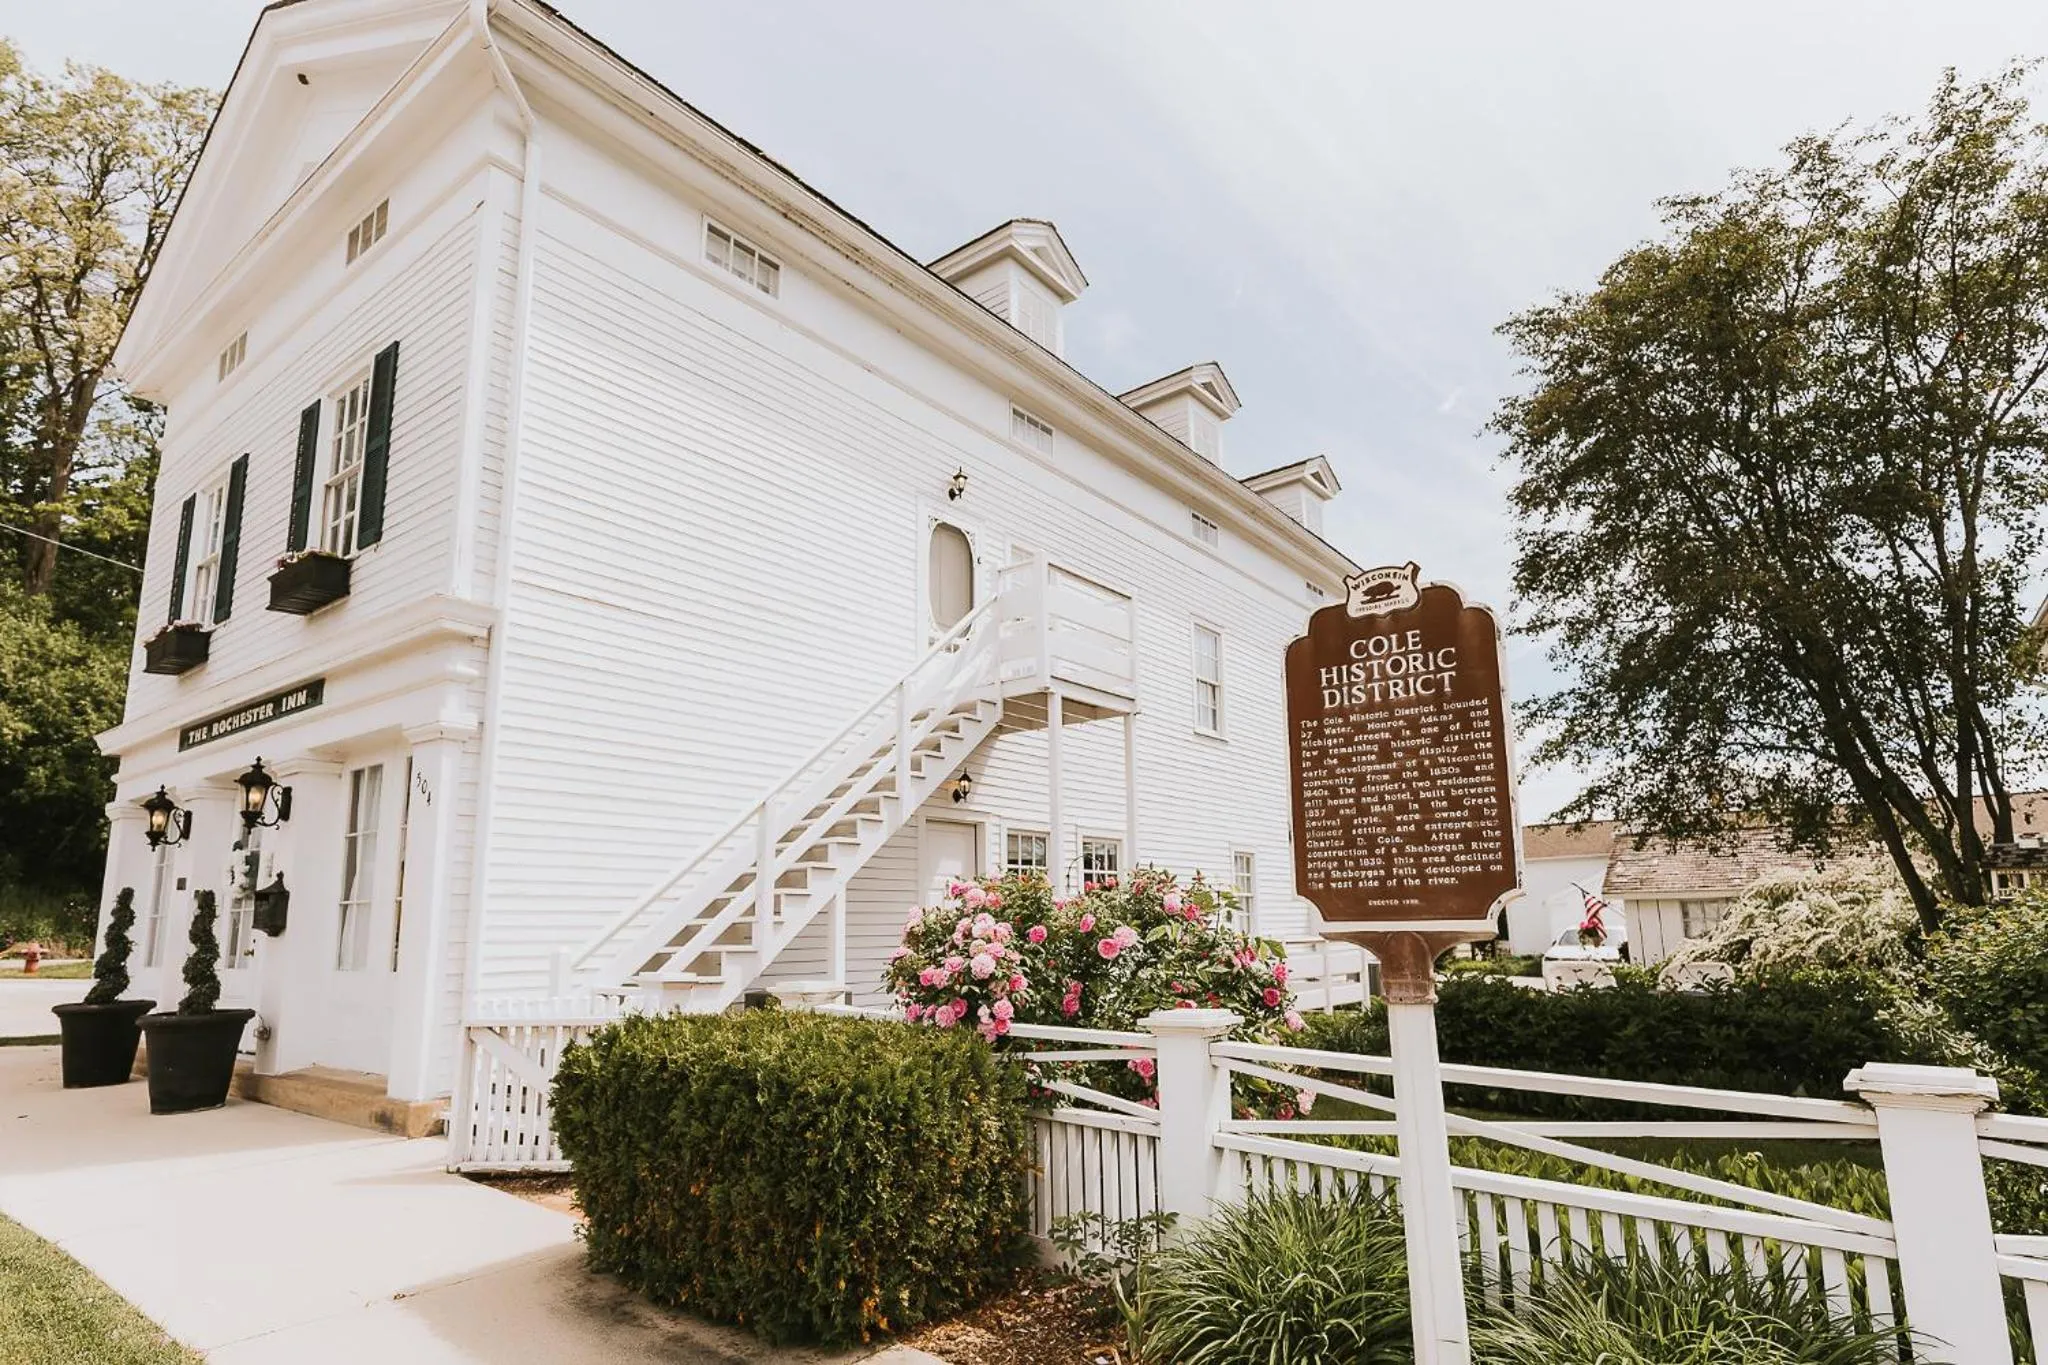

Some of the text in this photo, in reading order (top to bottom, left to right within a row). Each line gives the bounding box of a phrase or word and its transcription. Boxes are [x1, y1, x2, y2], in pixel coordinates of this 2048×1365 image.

[1351, 572, 1409, 590] WISCONSIN
[1350, 630, 1422, 658] COLE
[1320, 648, 1457, 687] HISTORIC
[1323, 672, 1456, 709] DISTRICT
[188, 689, 307, 744] THE ROCHESTER INN
[1301, 720, 1318, 728] The
[1324, 717, 1343, 725] Cole
[1350, 711, 1389, 722] Historic
[1443, 698, 1488, 710] bounded
[1301, 731, 1312, 739] by
[1420, 714, 1453, 724] Adams
[1470, 709, 1489, 717] and
[1301, 738, 1344, 748] Michigan
[1449, 723, 1460, 731] of
[1473, 720, 1490, 728] the
[1302, 731, 1491, 758] few remaining historic districts
[1302, 760, 1311, 768] in
[1352, 754, 1376, 762] state
[1420, 745, 1458, 755] display
[1475, 742, 1492, 750] the
[1302, 769, 1327, 778] early
[1336, 762, 1397, 774] development
[1438, 752, 1493, 764] Wisconsin
[1303, 778, 1354, 787] community
[1366, 774, 1390, 782] from
[1402, 771, 1419, 779] the
[1475, 763, 1494, 771] and
[1327, 798, 1354, 806] house
[1420, 790, 1445, 798] built
[1451, 786, 1496, 795] between
[1340, 787, 1356, 795] The
[1362, 782, 1406, 793] district's
[1340, 807, 1356, 815] and
[1431, 800, 1447, 808] the
[1463, 796, 1496, 806] Greek
[1306, 819, 1340, 828] Revival
[1435, 810, 1468, 818] owned
[1484, 808, 1497, 816] by
[1306, 830, 1342, 839] pioneer
[1352, 826, 1387, 835] settler
[1424, 820, 1499, 831] entrepreneur
[1307, 840, 1344, 848] Charles
[1378, 836, 1403, 844] Cole.
[1431, 833, 1460, 841] After
[1307, 849, 1367, 858] construction
[1405, 844, 1464, 853] Sheboygan
[1472, 842, 1501, 850] River
[1307, 861, 1338, 869] bridge
[1454, 852, 1502, 862] declined
[1331, 869, 1385, 878] Sheboygan
[1426, 865, 1481, 874] developed
[1429, 877, 1459, 885] river.
